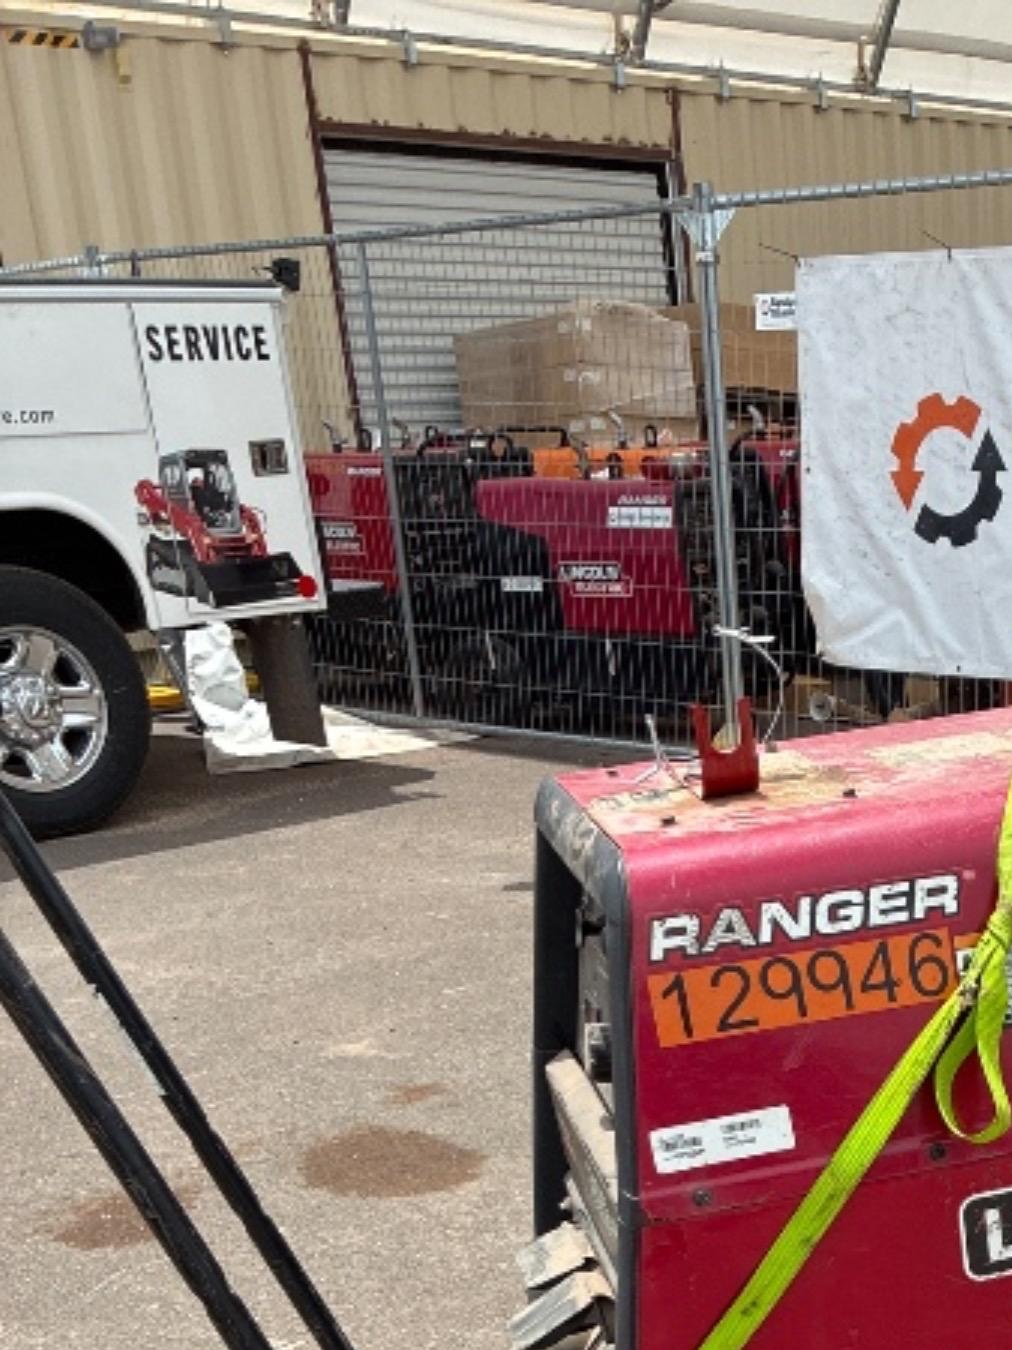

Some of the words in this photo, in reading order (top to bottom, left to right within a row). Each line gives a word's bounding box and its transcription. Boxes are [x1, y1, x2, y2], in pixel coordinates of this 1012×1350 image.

[145, 324, 271, 361] SERVICE
[650, 875, 959, 962] RANGER
[661, 932, 950, 1039] 129946
